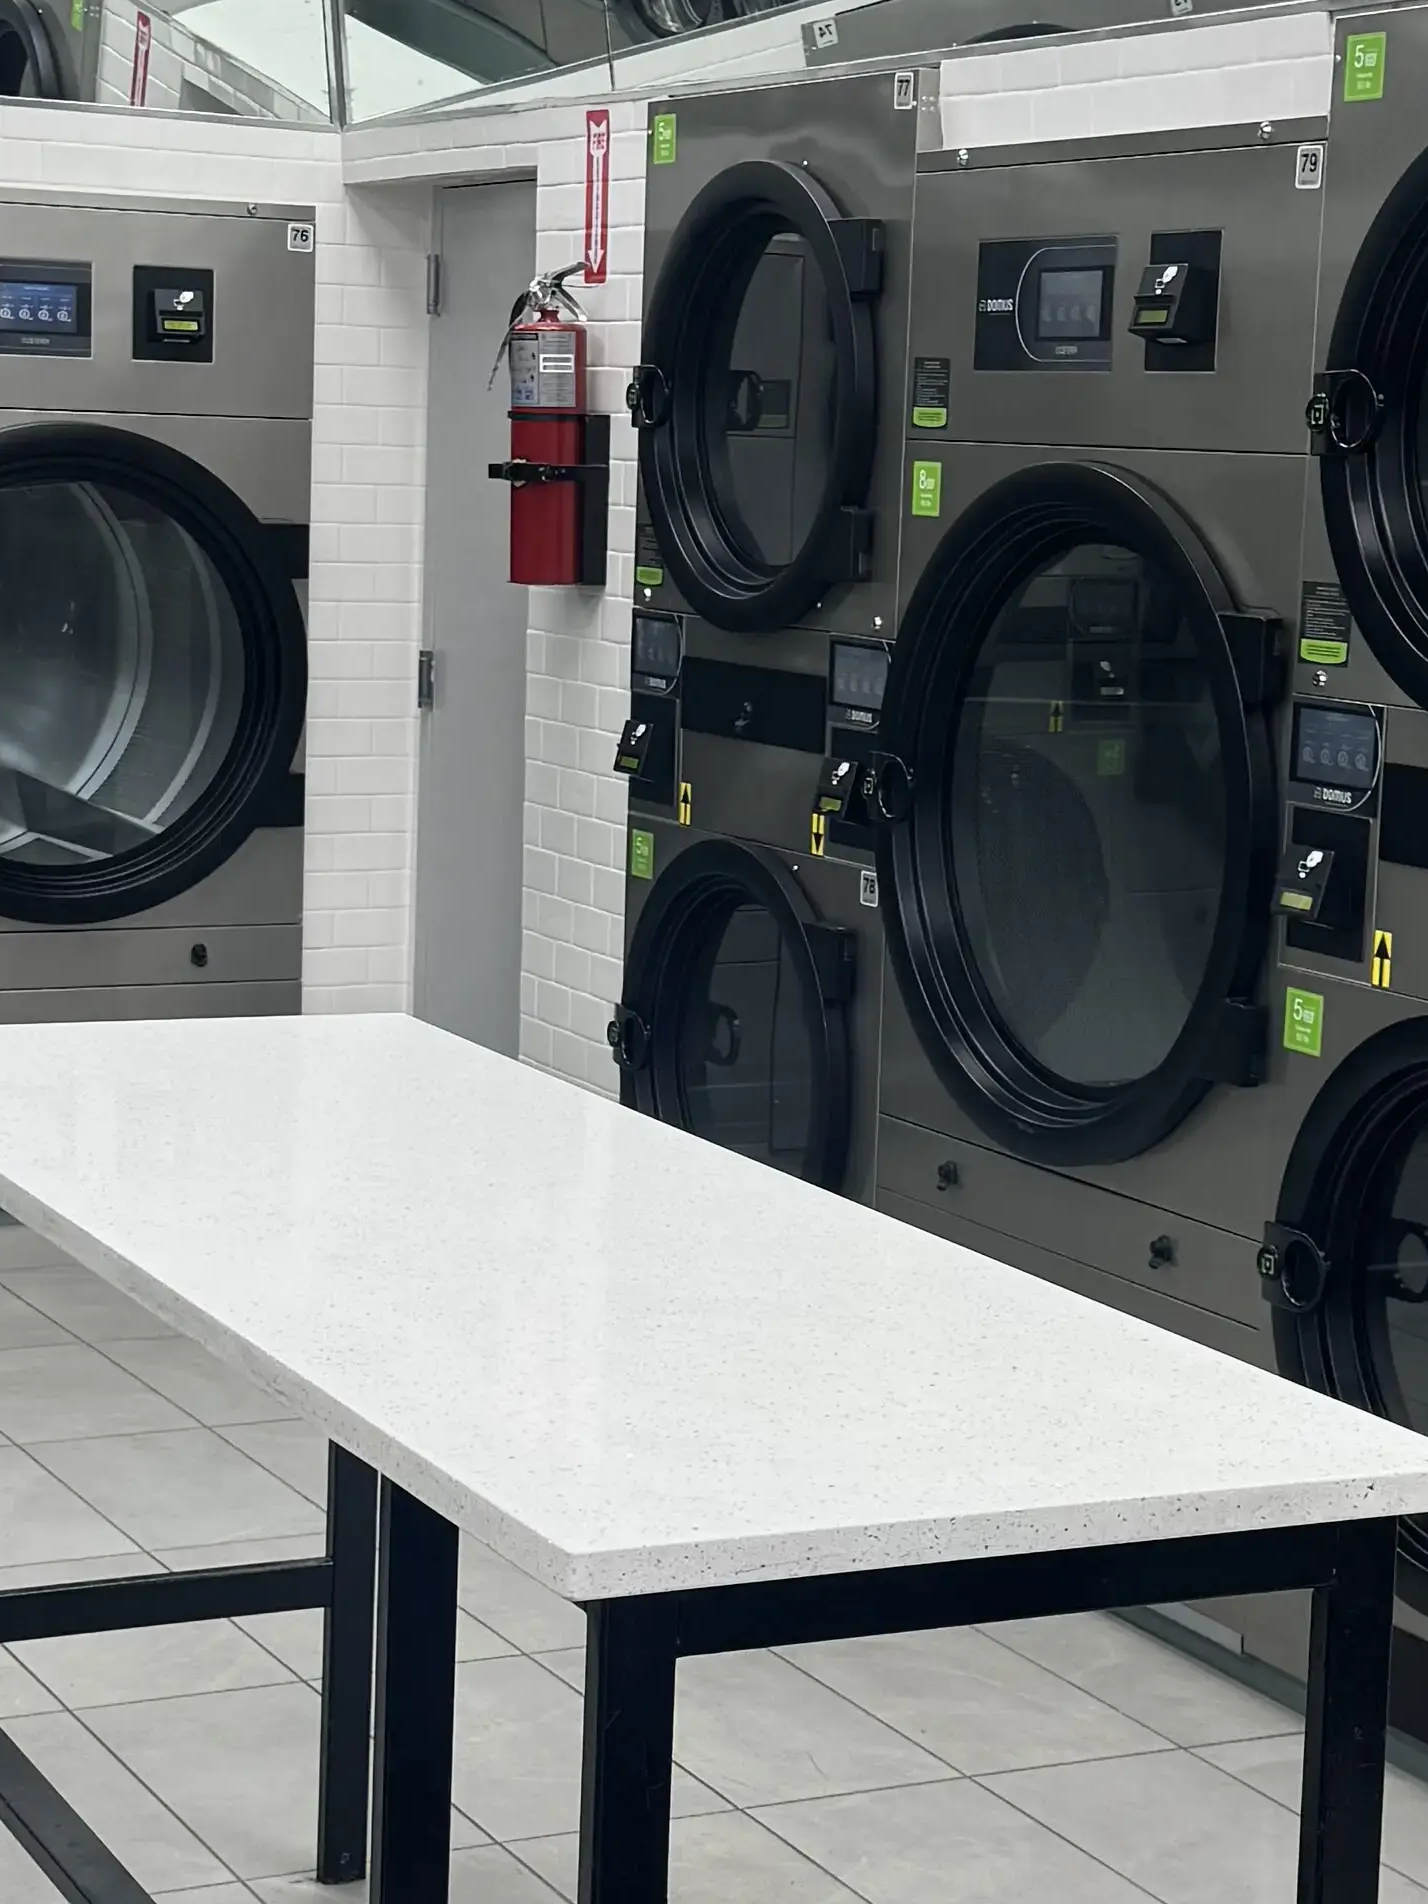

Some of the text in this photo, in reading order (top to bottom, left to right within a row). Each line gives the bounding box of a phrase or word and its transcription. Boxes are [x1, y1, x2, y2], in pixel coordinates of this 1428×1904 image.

[1354, 44, 1364, 68] 5
[897, 79, 910, 96] 77
[1301, 153, 1318, 174] 79
[292, 229, 309, 242] 76
[919, 469, 927, 489] 8
[1322, 788, 1352, 804] DOMUS
[864, 877, 875, 894] 78
[1293, 998, 1303, 1020] 5
